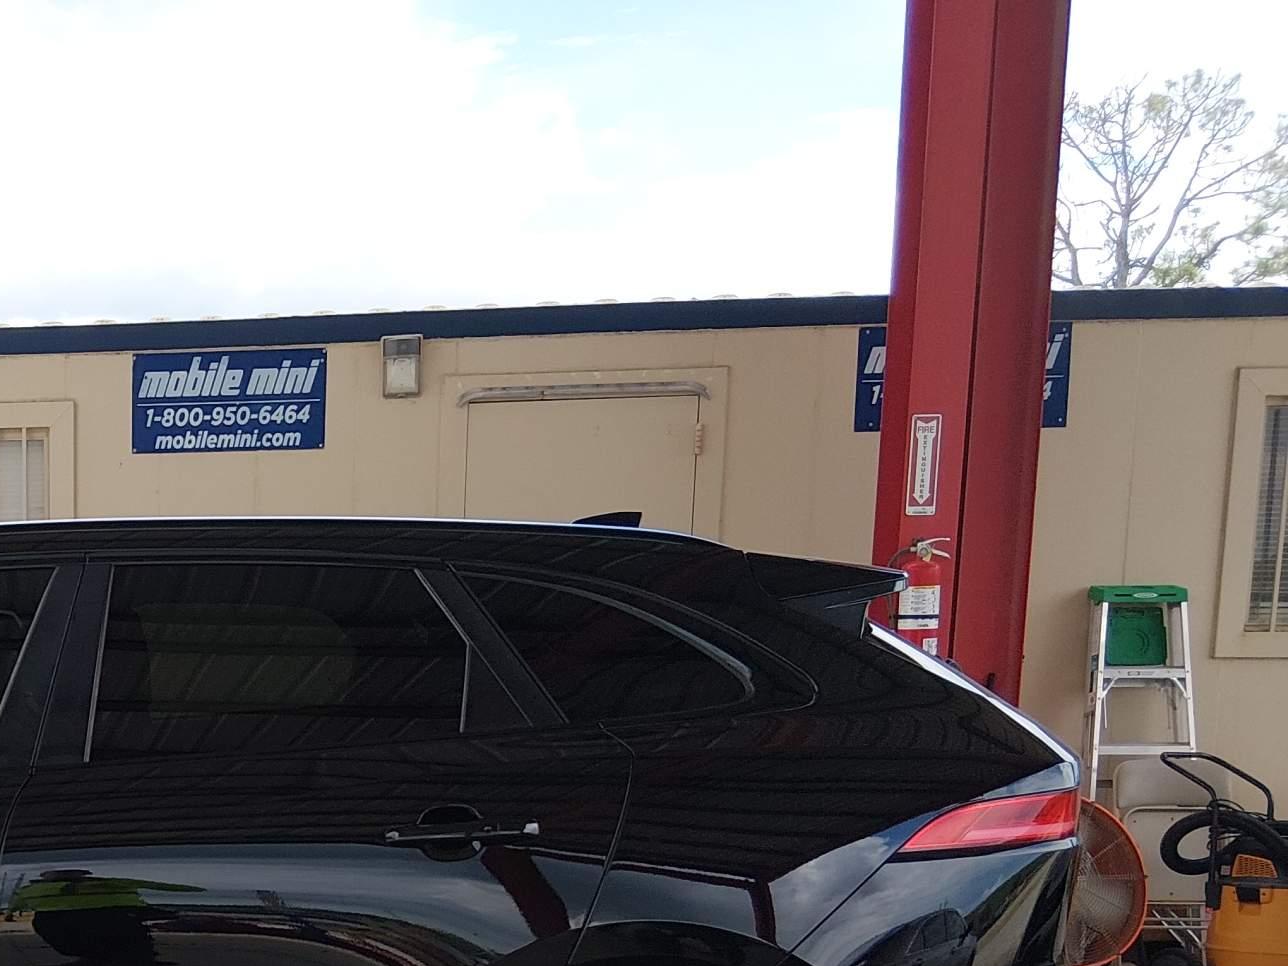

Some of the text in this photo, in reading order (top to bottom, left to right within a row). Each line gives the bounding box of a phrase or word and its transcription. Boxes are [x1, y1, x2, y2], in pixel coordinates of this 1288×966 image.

[138, 355, 321, 398] mobile mini
[145, 404, 311, 427] 1-800-950-6464
[154, 429, 302, 449] mobilemini.com
[918, 425, 936, 434] FIRE
